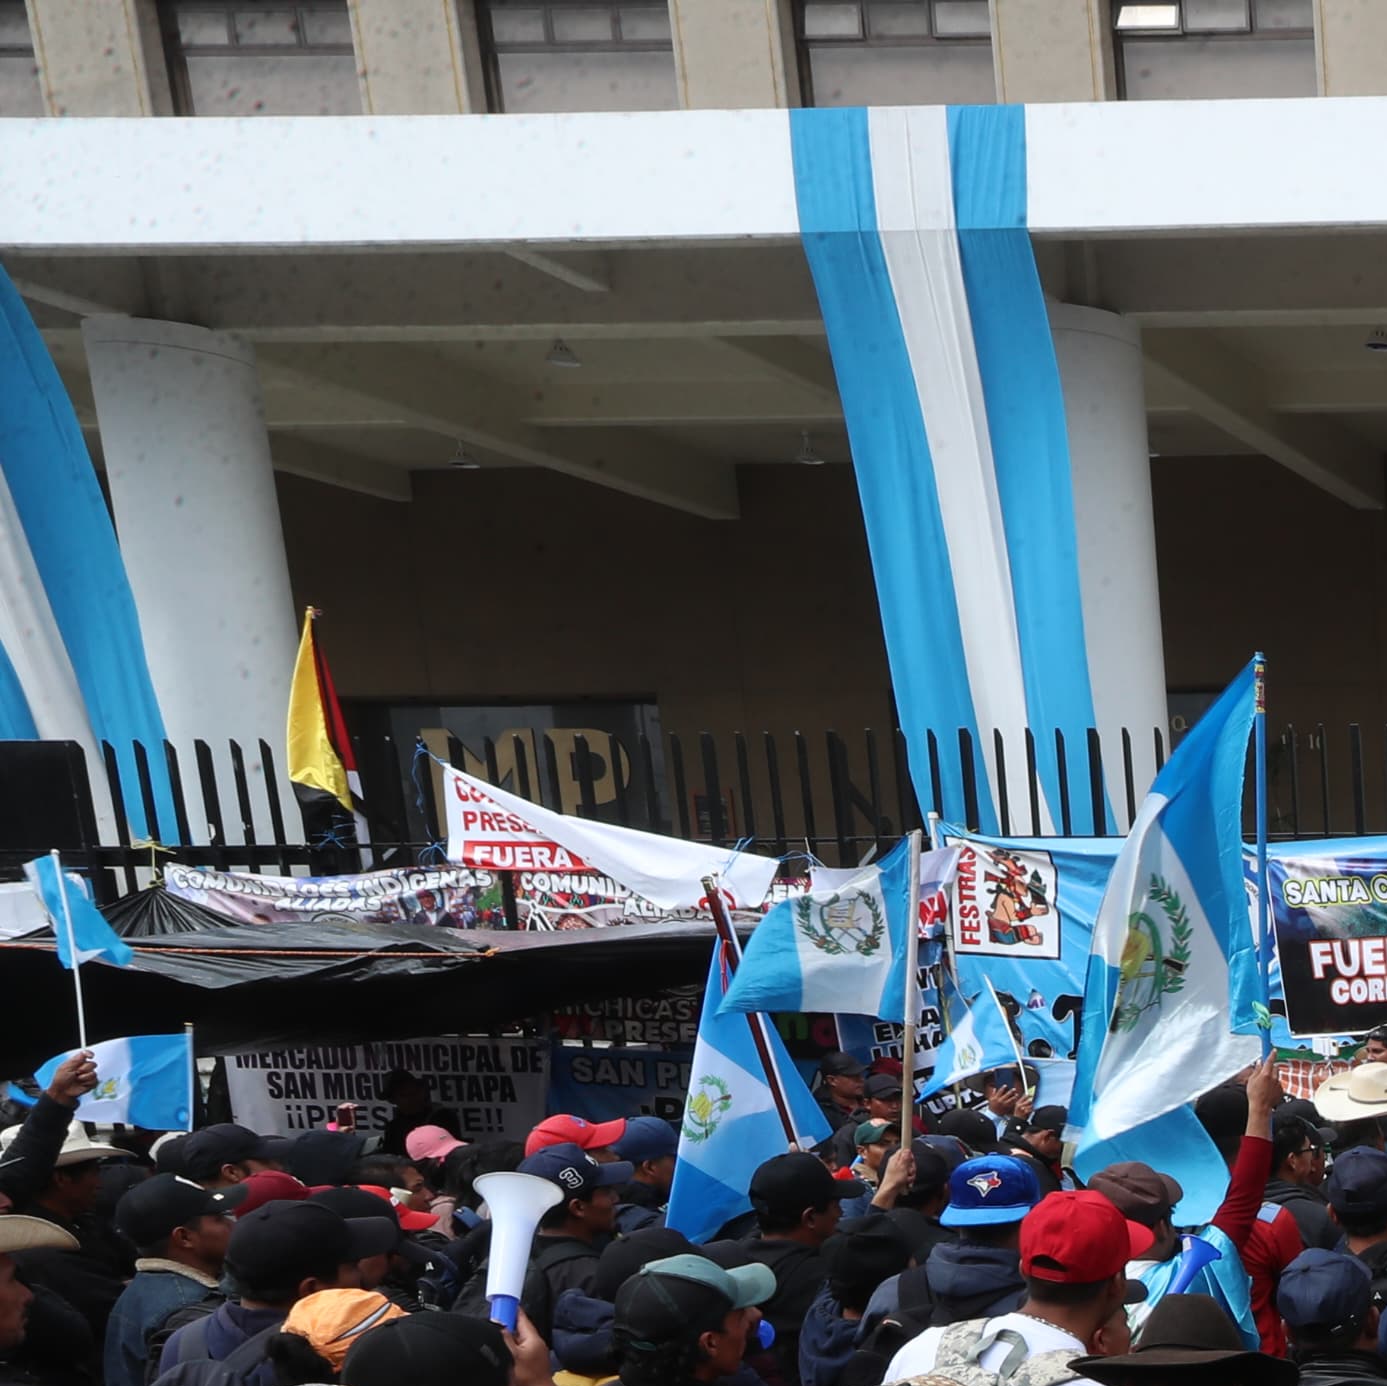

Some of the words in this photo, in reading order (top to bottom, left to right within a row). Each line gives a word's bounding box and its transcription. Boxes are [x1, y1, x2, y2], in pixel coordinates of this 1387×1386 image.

[473, 845, 571, 868] FUERA
[172, 868, 349, 899] COMUNIDADES
[957, 845, 981, 945] FESTRAS
[1283, 878, 1369, 907] SANTA
[273, 897, 383, 912] ALIADAS
[622, 898, 714, 921] ALIADA
[606, 1021, 696, 1043] PRESE
[236, 1046, 355, 1070] MERCADO
[364, 1042, 507, 1073] MUNICIPAL
[511, 1045, 545, 1074] DE
[571, 1056, 646, 1086] SAN
[267, 1071, 318, 1100] SAN
